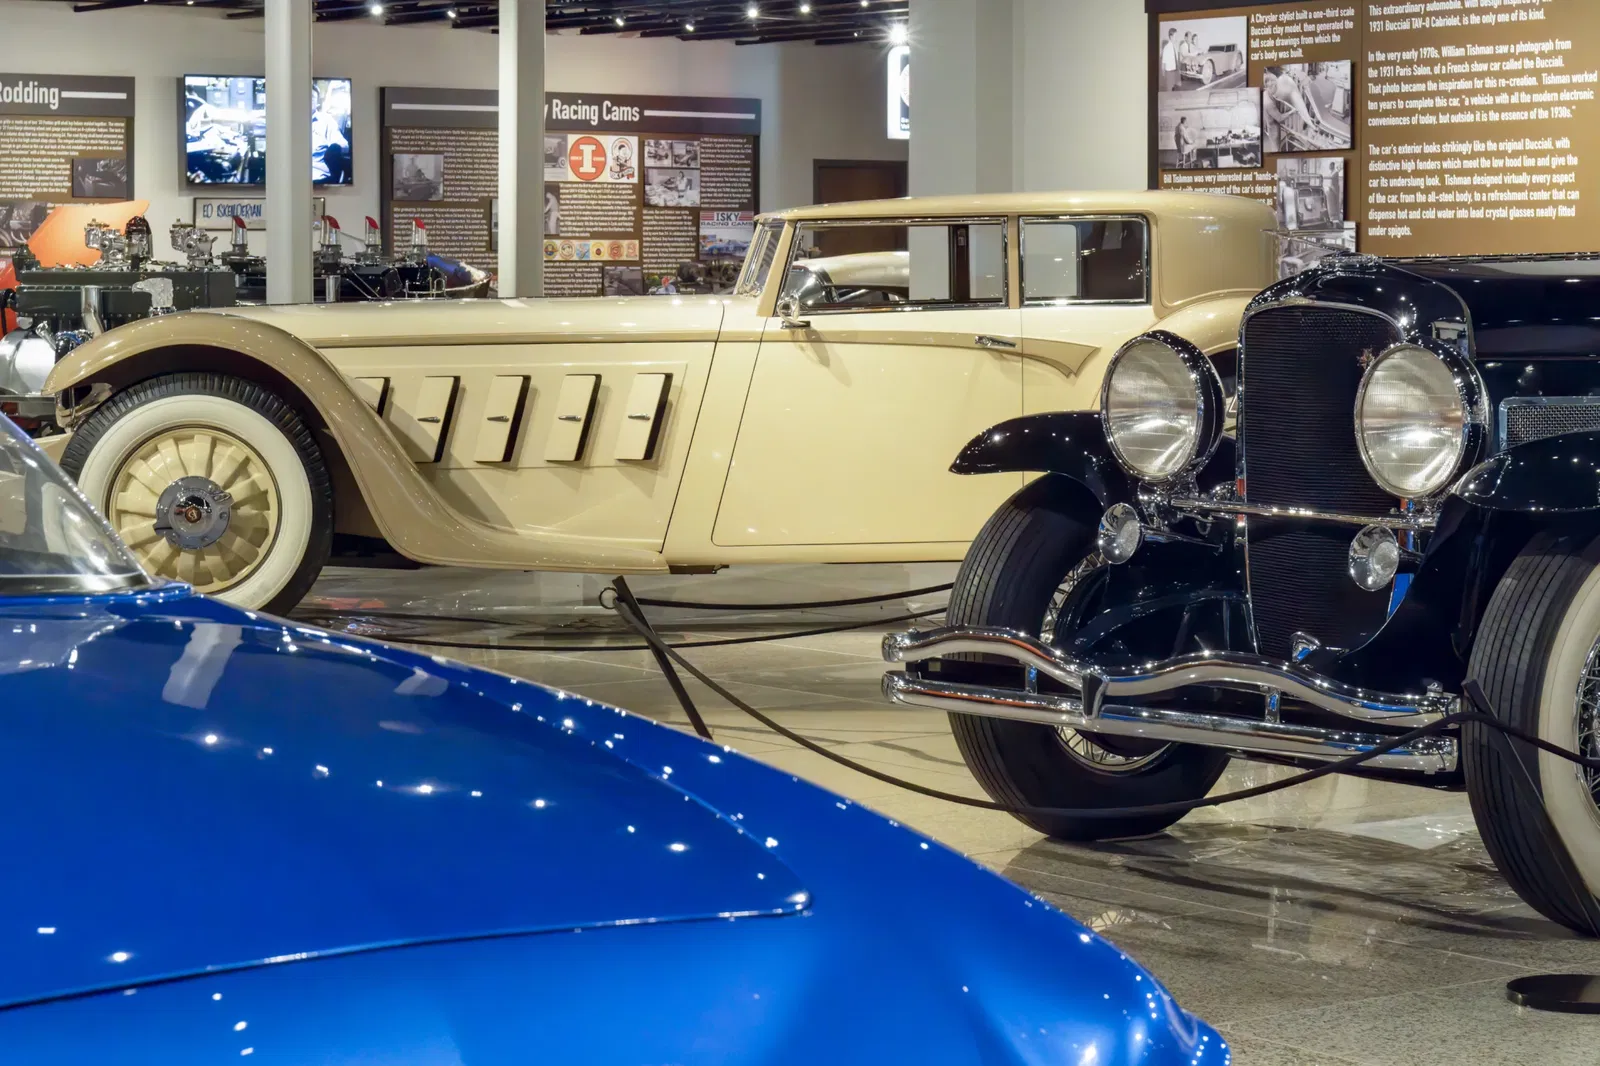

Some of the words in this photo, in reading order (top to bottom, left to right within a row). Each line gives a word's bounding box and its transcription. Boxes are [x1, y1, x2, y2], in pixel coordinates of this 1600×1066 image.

[1256, 13, 1277, 24] Chrysler
[1279, 11, 1294, 23] stylist
[1296, 10, 1307, 19] built
[1313, 8, 1339, 18] one-third
[1340, 6, 1354, 16] scale
[1369, 5, 1381, 16] This
[1383, 2, 1425, 14] extraordinary
[1251, 25, 1271, 35] Bucciali
[1273, 25, 1284, 35] clay
[1304, 22, 1315, 31] then
[1317, 20, 1343, 33] generated
[1345, 20, 1353, 28] the
[1369, 21, 1383, 32] 1931
[1386, 19, 1410, 30] Bucciali
[1470, 14, 1480, 24] the
[1482, 13, 1495, 25] only
[1497, 14, 1509, 22] one
[1529, 9, 1546, 20] kind.
[1251, 38, 1259, 48] full
[1261, 38, 1274, 47] scale
[1276, 36, 1299, 47] drawings
[1301, 35, 1313, 44] from
[1315, 33, 1331, 43] which
[1332, 33, 1340, 42] the
[1251, 51, 1263, 60] car's
[1265, 50, 1277, 61] body
[1291, 48, 1303, 57] built.
[1376, 51, 1385, 61] the
[1387, 52, 1400, 62] very
[1402, 49, 1418, 61] early
[1441, 46, 1465, 57] William
[1466, 45, 1493, 55] Tishman
[1495, 46, 1509, 54] saw
[1516, 40, 1554, 55] photograph
[1555, 40, 1571, 50] from
[1368, 68, 1378, 78] the
[1380, 66, 1393, 77] 1931
[1396, 66, 1412, 76] Paris
[1447, 62, 1469, 73] French
[1471, 61, 1488, 72] show
[1490, 62, 1501, 70] car
[1502, 59, 1522, 70] called
[1524, 58, 1534, 68] the
[1536, 57, 1564, 68] Bucciali.
[1368, 84, 1381, 94] That
[1383, 83, 1399, 96] photo
[1401, 82, 1425, 92] became
[1427, 80, 1437, 91] the
[1439, 79, 1472, 92] inspiration
[1474, 78, 1483, 88] for
[1485, 77, 1497, 87] this
[1499, 75, 1538, 87] re-creation.
[1542, 74, 1570, 84] Tishman
[1572, 72, 1597, 83] worked
[0, 80, 59, 110] odding
[1368, 101, 1378, 110] ten
[1379, 101, 1396, 112] years
[1406, 97, 1433, 110] complete
[1435, 96, 1447, 106] this
[1471, 94, 1493, 105] vehicle
[1495, 93, 1509, 104] with
[1520, 92, 1531, 102] the
[1533, 91, 1558, 102] modern
[1560, 89, 1594, 100] electronic
[552, 99, 599, 126] Racing
[602, 100, 640, 122] Cams
[1368, 115, 1410, 126] conveniences
[1439, 113, 1449, 122] but
[1451, 111, 1474, 122] outside
[1489, 110, 1499, 120] the
[1501, 111, 1528, 120] essence
[1538, 108, 1548, 118] the
[1369, 145, 1379, 155] The
[1381, 144, 1397, 154] car's
[1399, 143, 1422, 154] exterior
[1424, 143, 1440, 153] looks
[1442, 142, 1472, 154] strikingly
[1474, 141, 1485, 151] like
[1487, 141, 1497, 151] the
[1499, 140, 1524, 153] original
[1556, 138, 1570, 148] with
[580, 144, 596, 173] I
[1369, 160, 1400, 170] distinctive
[1402, 159, 1415, 172] high
[1417, 159, 1441, 169] fenders
[1442, 158, 1461, 168] which
[1463, 159, 1479, 168] meet
[1481, 157, 1490, 167] the
[1492, 157, 1504, 167] low
[1506, 156, 1521, 167] hood
[1523, 156, 1535, 166] line
[1537, 156, 1549, 166] and
[1552, 155, 1565, 168] give
[1567, 155, 1578, 165] the
[1390, 176, 1424, 188] underslung
[1426, 175, 1441, 185] look.
[1444, 175, 1471, 185] Tishman
[1473, 174, 1502, 186] designed
[1504, 173, 1530, 185] virtually
[1532, 175, 1551, 185] every
[1552, 173, 1575, 184] aspect
[1376, 192, 1386, 202] the
[1400, 192, 1415, 202] from
[1416, 192, 1426, 202] the
[1428, 191, 1454, 202] all-steel
[1474, 192, 1480, 201] to
[1488, 190, 1528, 200] refreshment
[1530, 191, 1550, 200] center
[1552, 189, 1565, 199] that
[716, 212, 740, 221] ISKY
[1369, 209, 1396, 221] dispense
[1398, 208, 1408, 218] hot
[1409, 208, 1420, 218] and
[1422, 208, 1435, 218] cold
[1437, 209, 1455, 218] water
[1457, 208, 1469, 217] into
[1470, 207, 1484, 217] lead
[1485, 207, 1508, 220] crystal
[1509, 207, 1534, 219] glasses
[1536, 206, 1556, 219] neatly
[1558, 206, 1575, 216] fitted
[1368, 225, 1387, 235] under
[1388, 225, 1412, 237] spigots.
